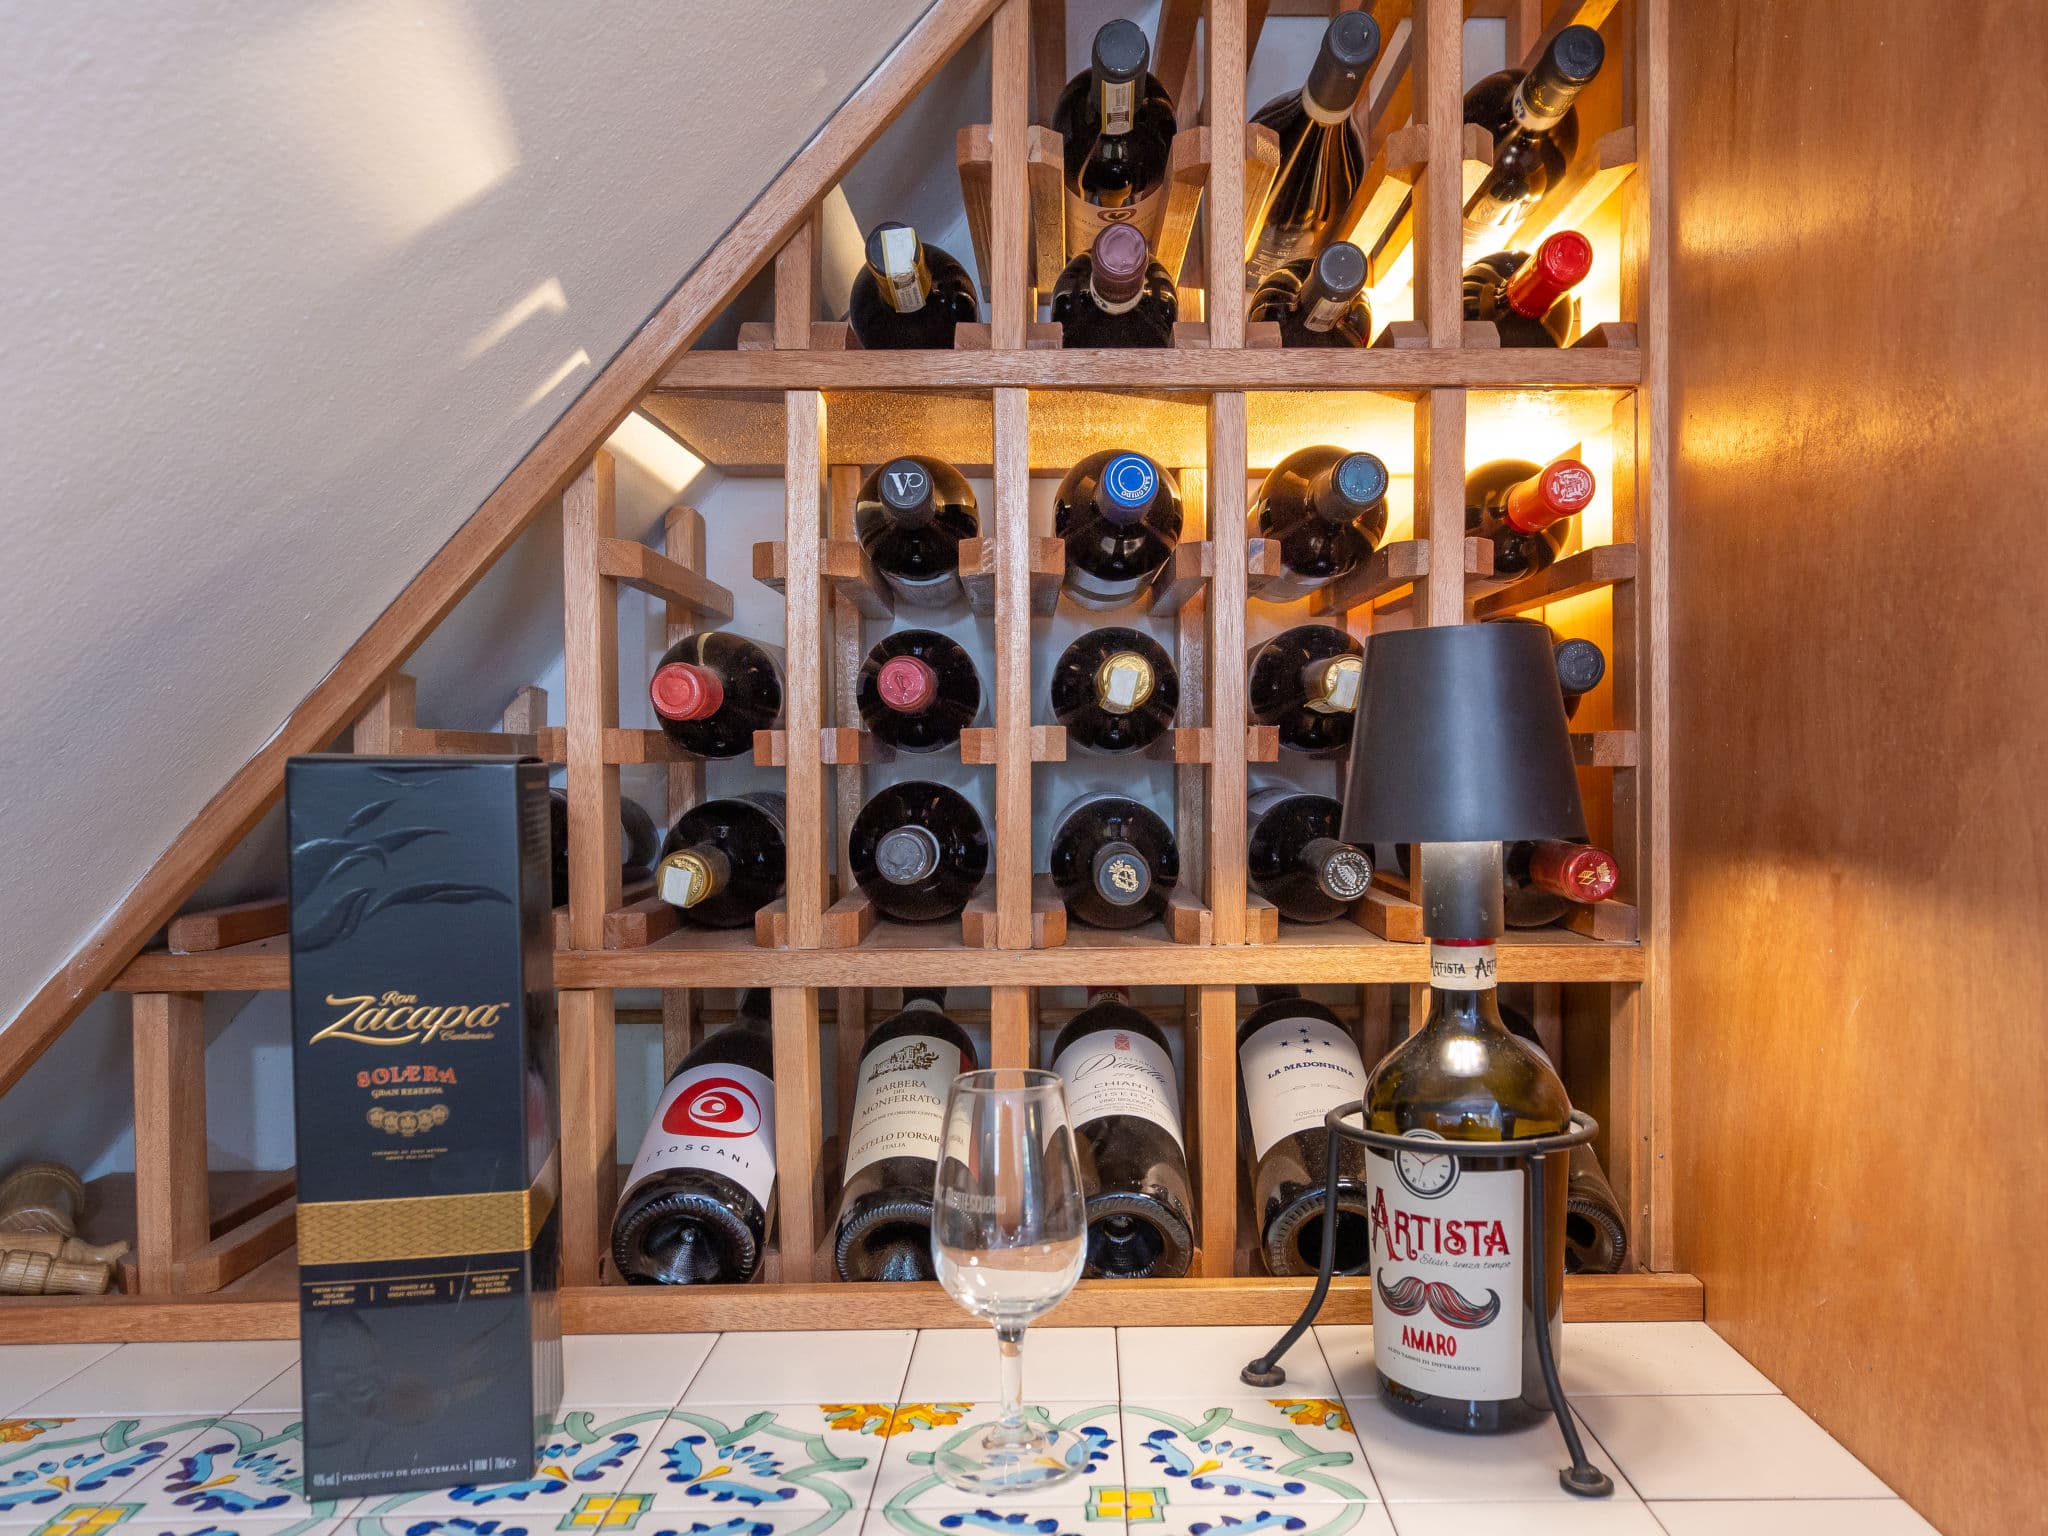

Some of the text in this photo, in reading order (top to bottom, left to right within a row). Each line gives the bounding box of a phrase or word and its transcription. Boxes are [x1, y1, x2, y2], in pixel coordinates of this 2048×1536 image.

[379, 990, 418, 1007] Ron
[309, 993, 506, 1046] Zacapa
[356, 1065, 457, 1088] SOLERA
[1266, 1061, 1355, 1080] LA MADONNINA
[875, 1079, 927, 1095] BARBERA
[1094, 1080, 1155, 1094] CHIANTI
[861, 1094, 941, 1118] MONFERRATO
[1094, 1091, 1156, 1105] RISERVA
[851, 1131, 941, 1161] CASTELLO D'ORSAR
[881, 1142, 907, 1152] ITALIA
[1371, 1186, 1511, 1262] ARTISTA
[1402, 1324, 1457, 1358] AMARO
[396, 1469, 408, 1477] DE
[410, 1463, 468, 1476] GUATEMALA
